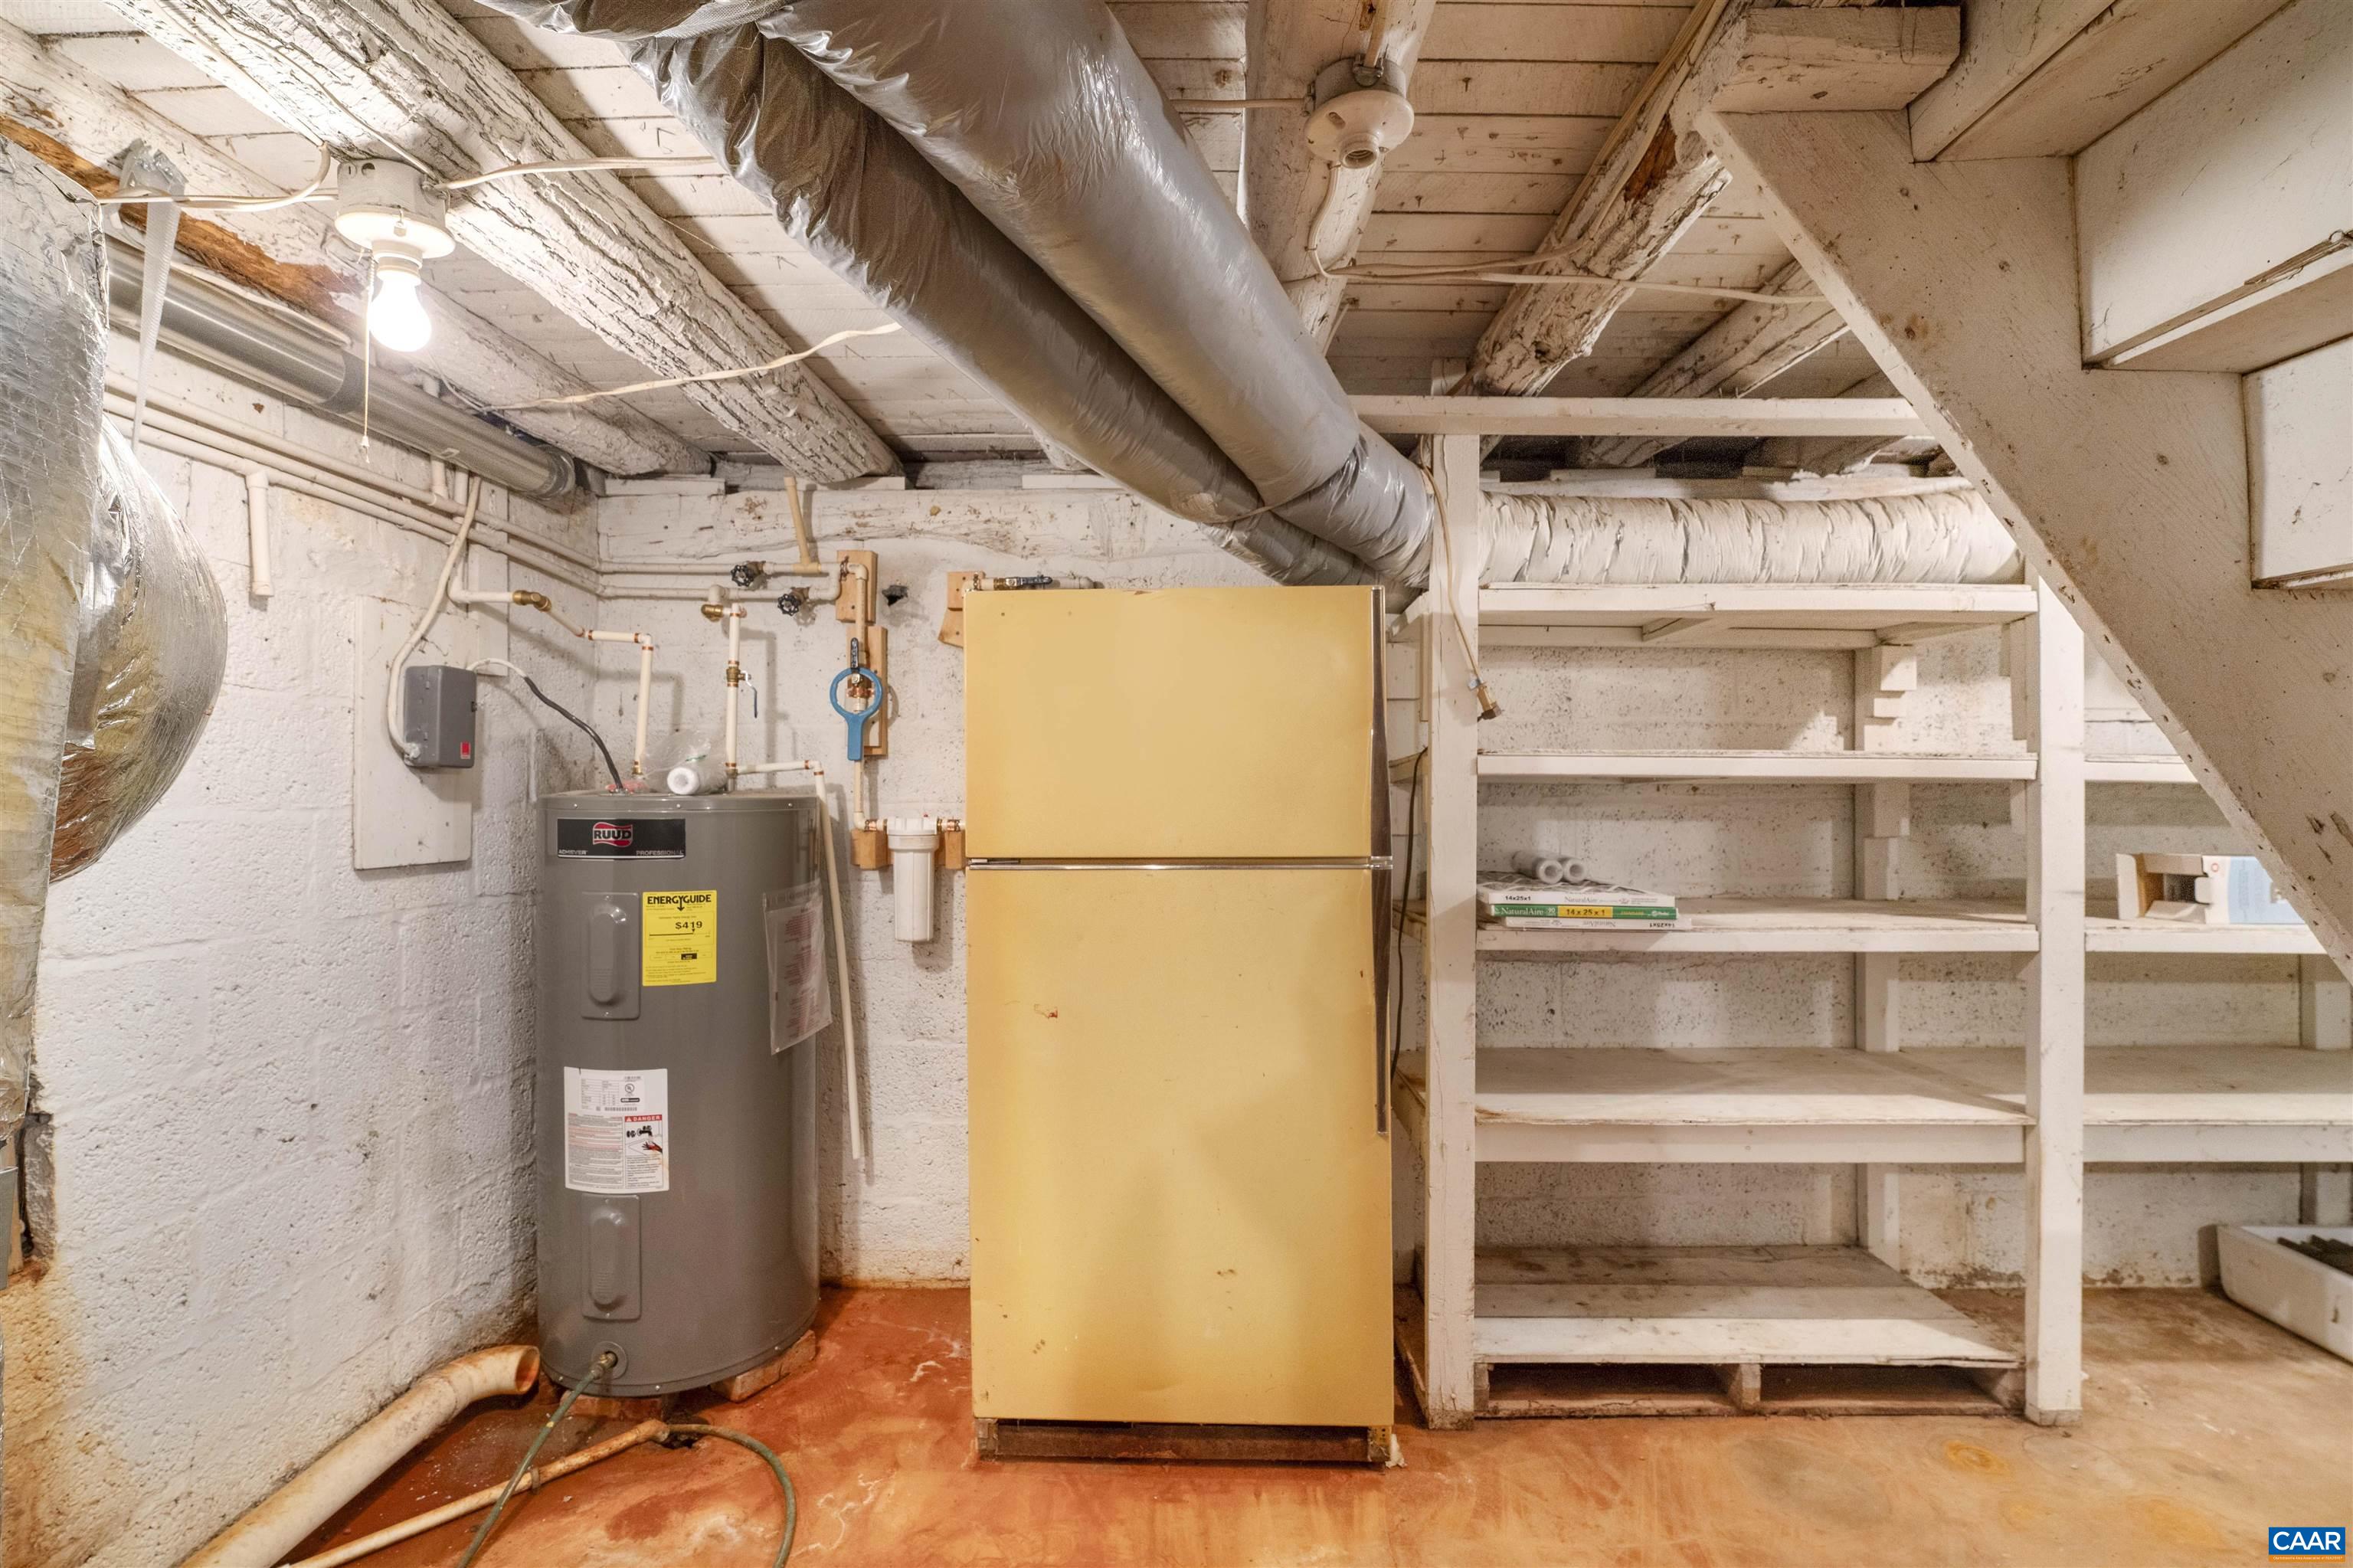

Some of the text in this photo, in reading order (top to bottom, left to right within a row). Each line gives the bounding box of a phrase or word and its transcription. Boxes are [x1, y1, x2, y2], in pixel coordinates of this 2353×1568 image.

[594, 830, 632, 840] RUUD
[647, 894, 712, 906] ENERGYGUIDE
[1500, 907, 1544, 915] NaturalAire
[675, 921, 703, 929] $419
